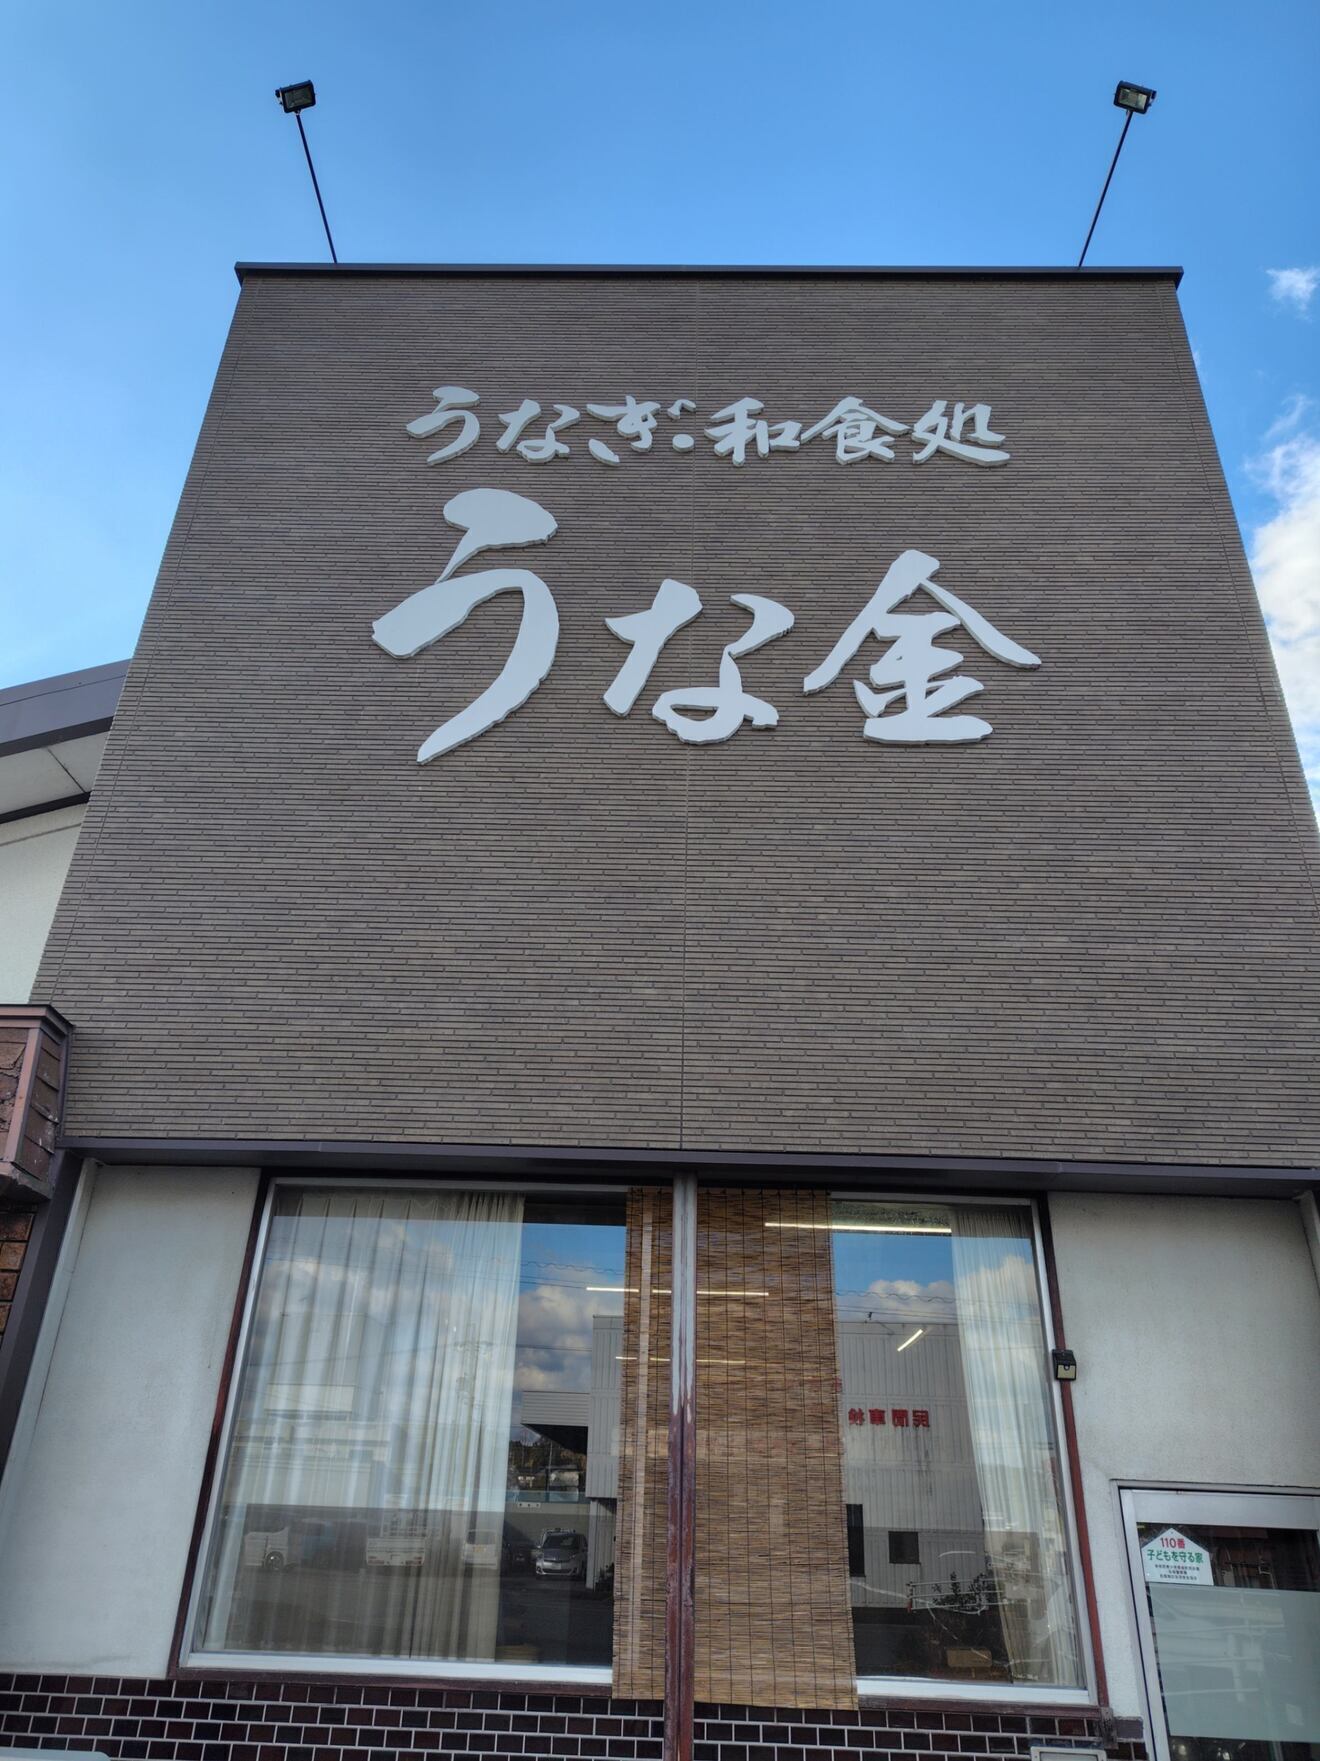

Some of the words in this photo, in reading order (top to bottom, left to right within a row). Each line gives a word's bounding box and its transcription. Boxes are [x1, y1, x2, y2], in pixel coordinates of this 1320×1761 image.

[371, 487, 1042, 765] うな金
[1161, 1538, 1185, 1549] 110番
[1147, 1550, 1203, 1563] 子どもを守る家
